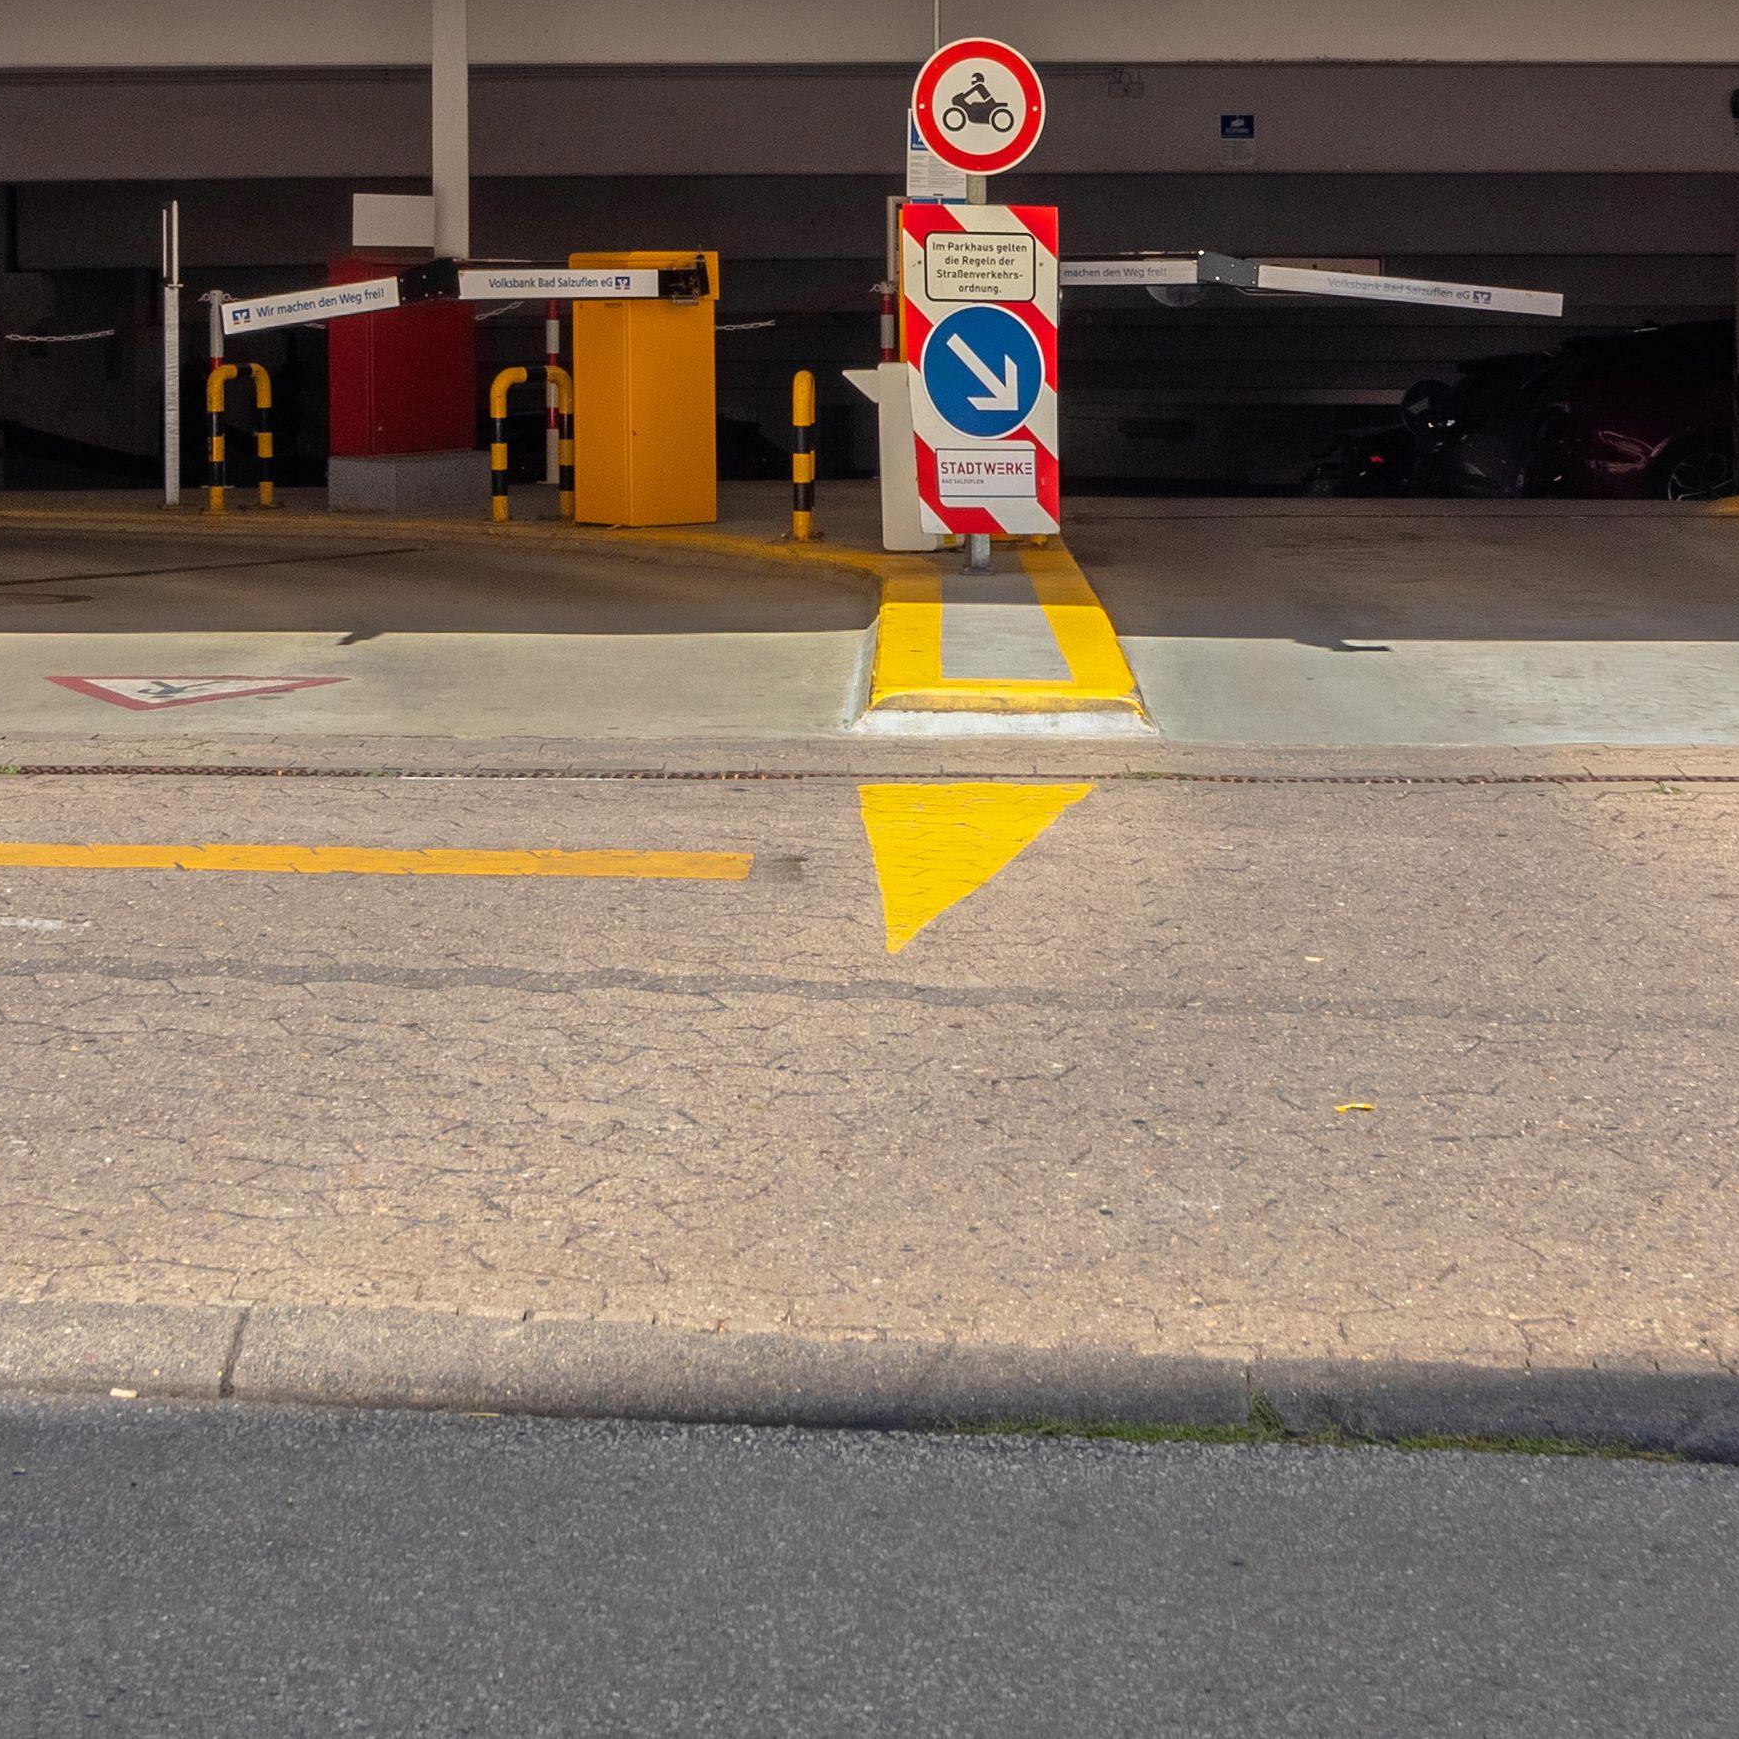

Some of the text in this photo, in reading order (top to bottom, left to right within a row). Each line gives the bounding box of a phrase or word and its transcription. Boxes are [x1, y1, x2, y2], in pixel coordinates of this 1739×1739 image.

[932, 242, 1027, 254] Im Parkhaus gelten
[945, 256, 1015, 267] die Regeln der
[936, 269, 1023, 280] Straßenverkehrs-
[1064, 268, 1101, 277] machen
[1102, 267, 1121, 277] den
[1124, 268, 1145, 278] Weg
[489, 276, 613, 288] Volksbank Bad Salzuflen eG
[959, 283, 1002, 295] ordnung.
[1383, 283, 1404, 294] Bad
[256, 306, 275, 318] Wir
[277, 301, 316, 315] machen
[318, 297, 337, 309] den
[339, 293, 362, 305] Weg
[940, 461, 1033, 475] STADTWERKE
